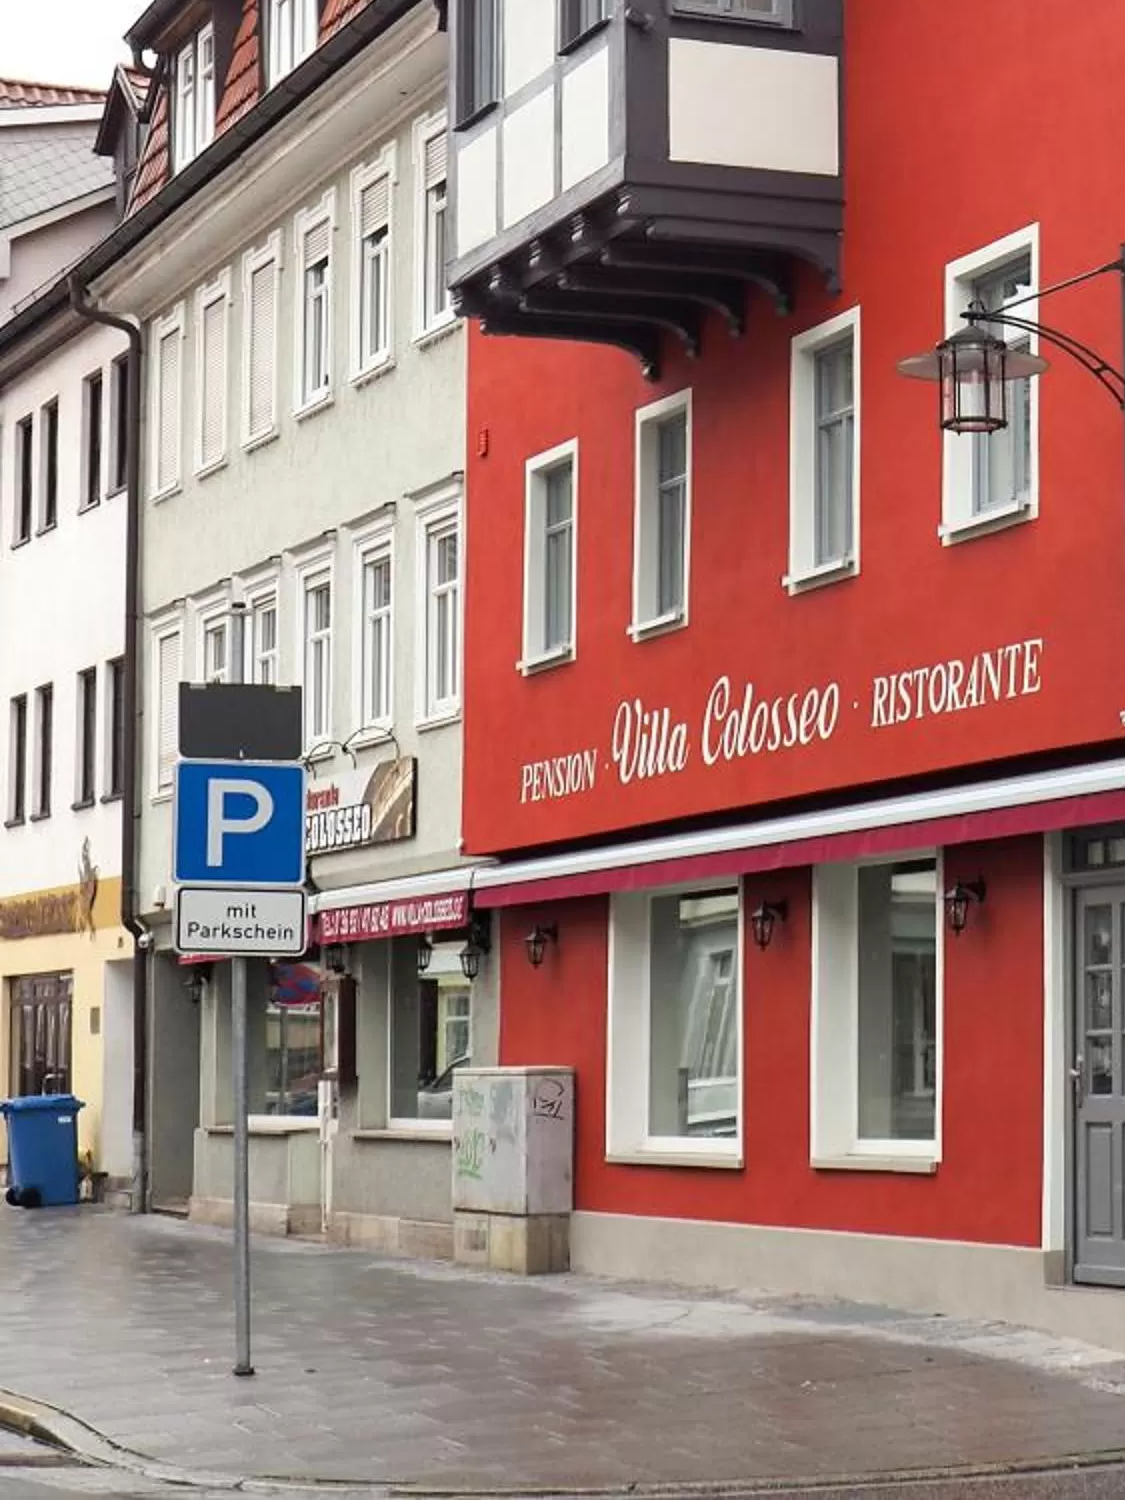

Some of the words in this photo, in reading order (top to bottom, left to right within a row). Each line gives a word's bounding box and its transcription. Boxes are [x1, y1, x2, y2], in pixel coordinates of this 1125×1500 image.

[521, 748, 598, 804] PENSION
[612, 698, 691, 785] Villa
[702, 676, 839, 765] Colosseo
[871, 638, 1043, 727] RISTORANTE
[206, 777, 274, 867] P
[187, 921, 294, 940] Parkschein
[227, 903, 256, 918] mit
